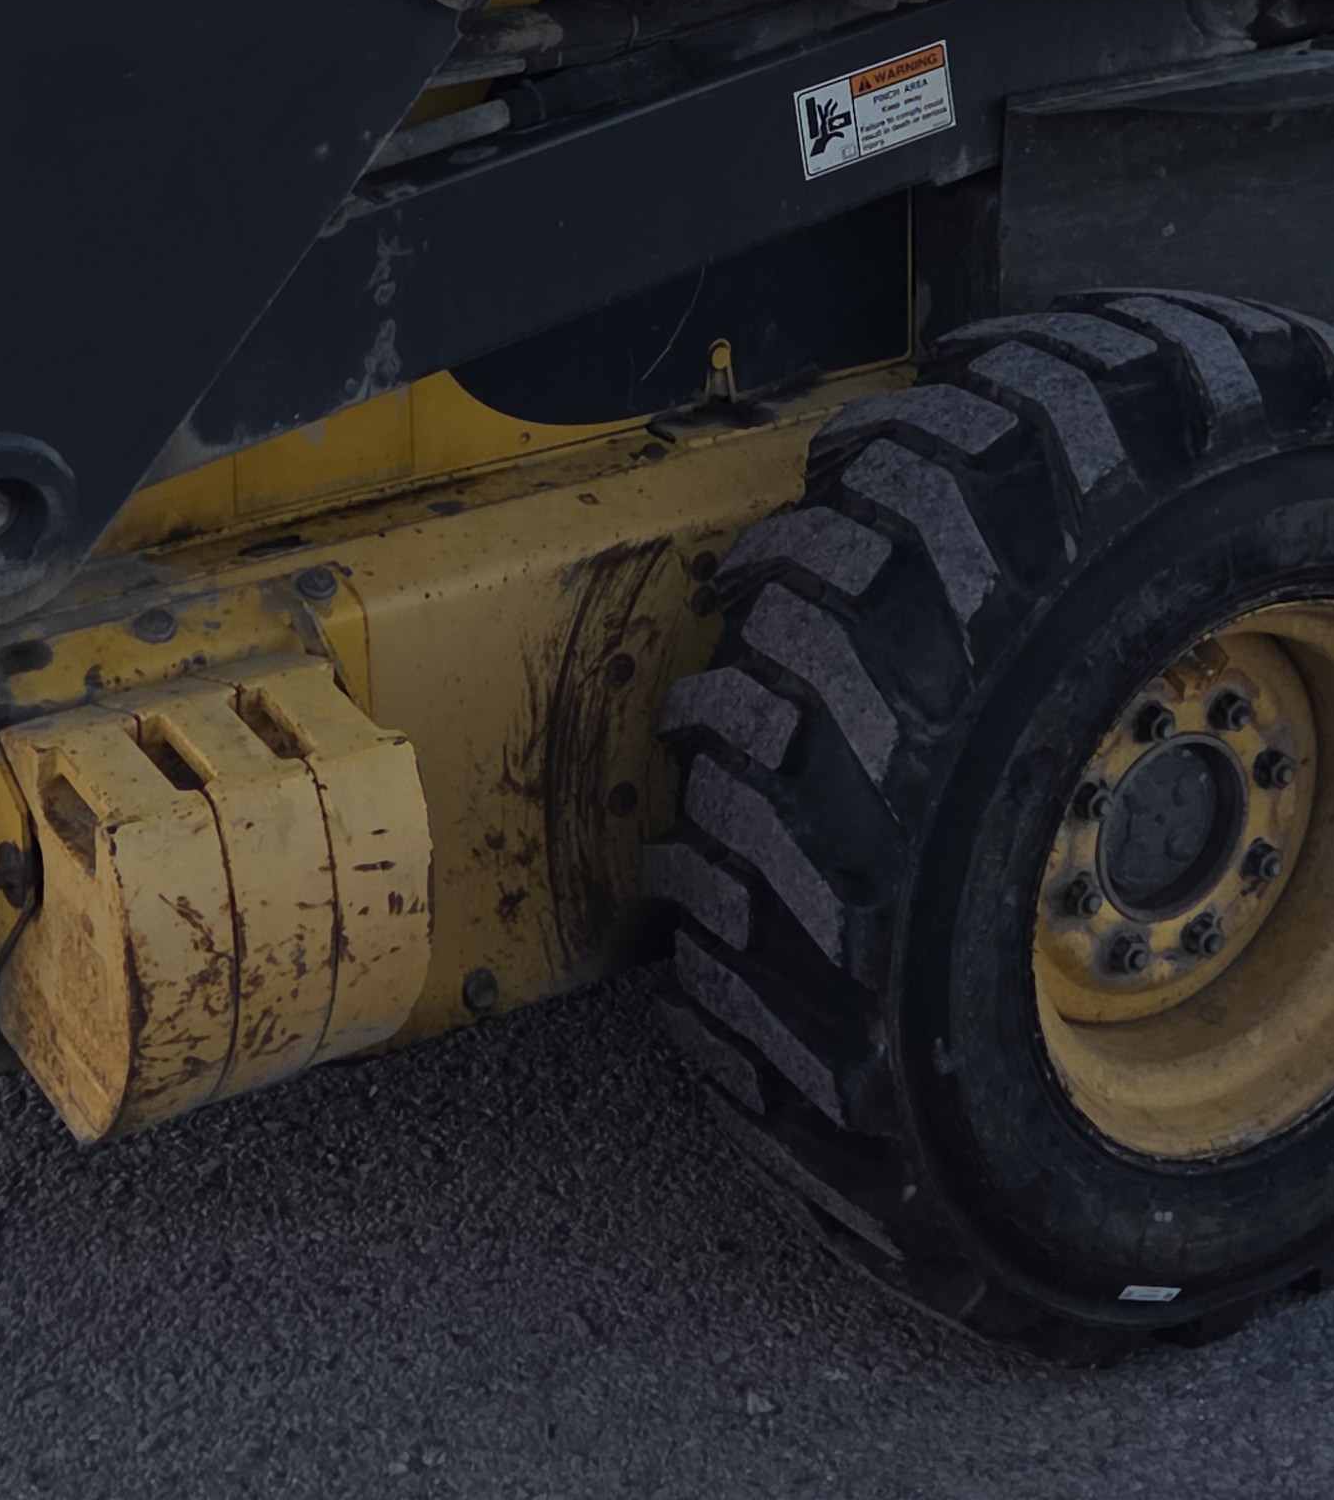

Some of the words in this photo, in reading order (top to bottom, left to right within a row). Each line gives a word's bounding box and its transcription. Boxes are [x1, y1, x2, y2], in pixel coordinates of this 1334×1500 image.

[873, 53, 938, 83] WARNING
[873, 88, 900, 105] PINCH
[904, 78, 928, 93] AREA
